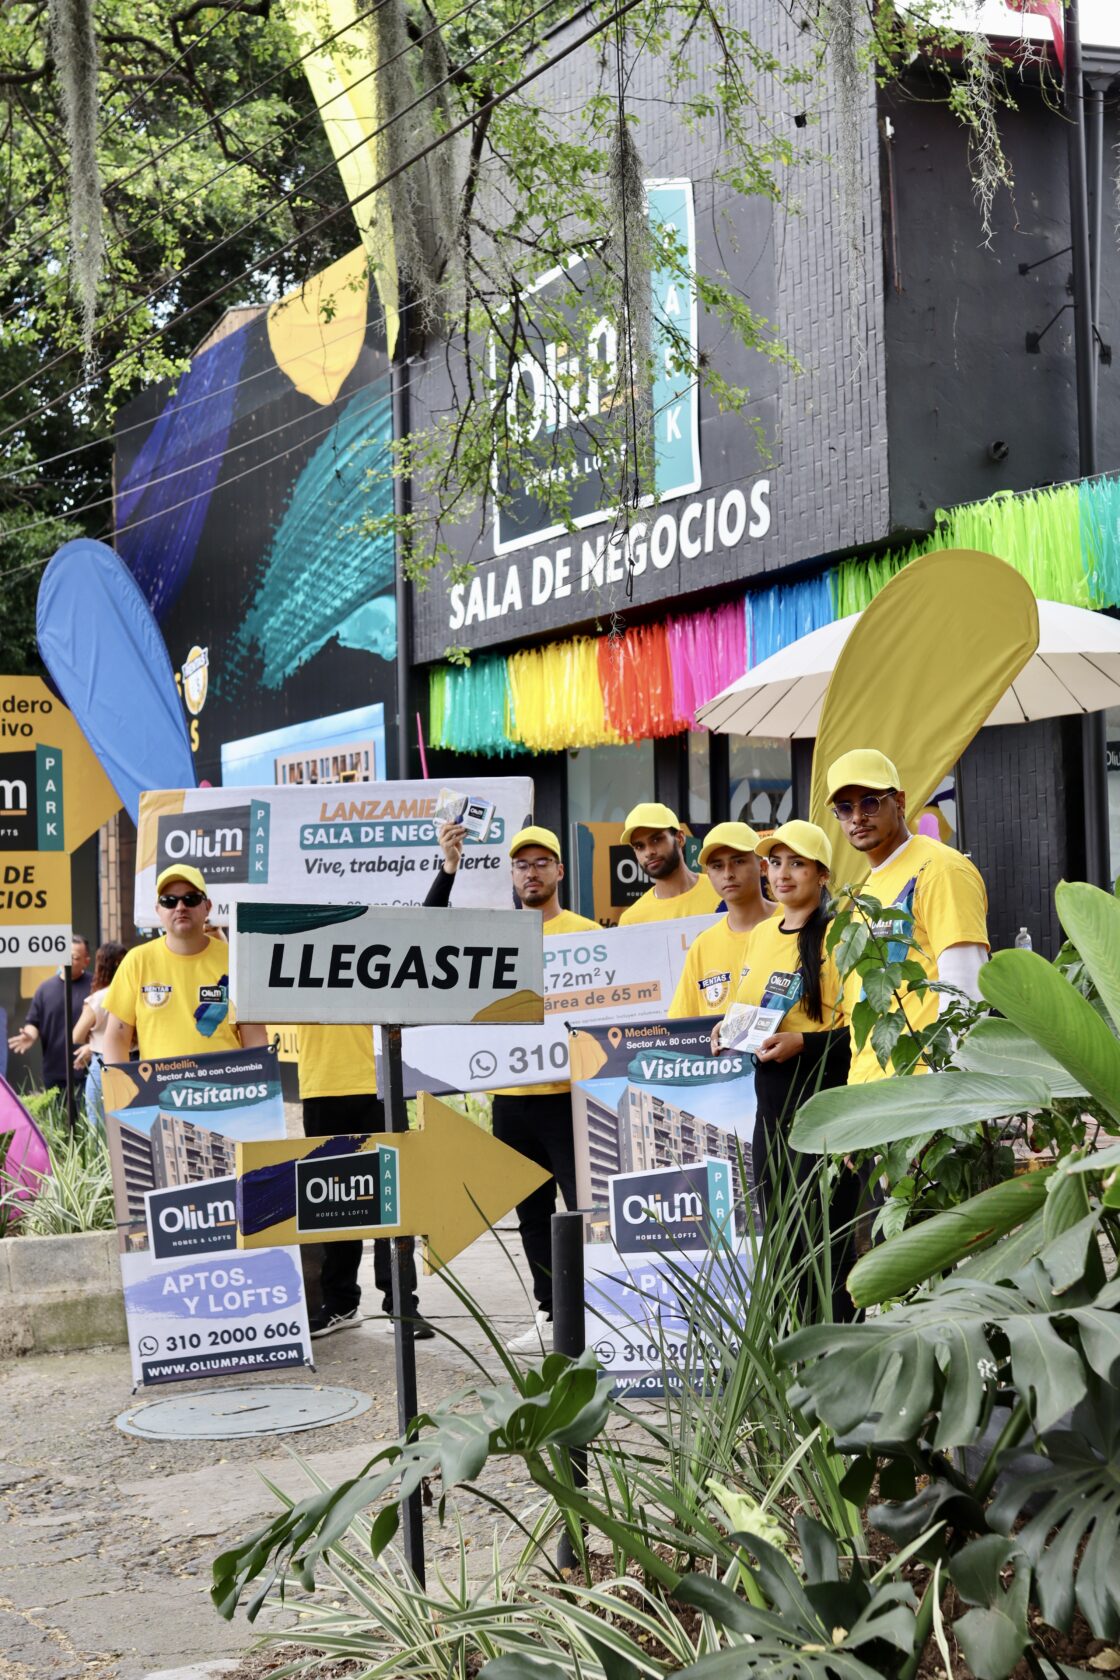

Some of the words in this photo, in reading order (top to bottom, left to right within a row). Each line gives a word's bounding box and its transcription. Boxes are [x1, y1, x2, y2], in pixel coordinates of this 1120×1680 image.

[449, 564, 522, 630] SALA
[532, 547, 571, 606] DE
[581, 479, 771, 591] NEGOCIOS
[0, 695, 53, 713] dero
[45, 757, 57, 836] PARK
[319, 798, 437, 822] LANZAMIE
[164, 828, 243, 858] Olium
[255, 810, 265, 871] PARK
[303, 827, 353, 845] SALA
[360, 826, 384, 843] DE
[391, 821, 502, 841] NEGS
[4, 866, 35, 884] DE
[305, 858, 346, 877] Vive,
[351, 855, 417, 877] trabaja
[419, 858, 429, 871] e
[28, 935, 66, 953] 606
[268, 943, 519, 990] LLEGASTE
[544, 944, 608, 969] PTOS
[605, 969, 616, 986] y
[702, 974, 727, 988] RENTAS
[544, 995, 579, 1011] área
[585, 991, 605, 1005] de
[611, 988, 631, 1002] 65
[624, 1025, 671, 1038] Medellín,
[626, 1041, 653, 1049] Sector
[655, 1039, 667, 1047] Av.
[669, 1038, 679, 1046] 80
[155, 1059, 198, 1072] Medellín,
[508, 1041, 569, 1074] 310
[641, 1057, 742, 1079] Visítanos
[156, 1073, 182, 1082] Sector
[184, 1070, 196, 1079] Av.
[198, 1069, 207, 1077] 80
[225, 1063, 263, 1073] Colombia
[171, 1083, 268, 1107] Visítanos
[305, 1174, 374, 1203] Olium
[383, 1153, 392, 1212] PARK
[622, 1191, 703, 1225] Olium
[714, 1172, 727, 1235] PAR
[159, 1200, 235, 1233] Olium
[172, 1238, 198, 1246] HOMES
[208, 1234, 231, 1242] LOFTS
[162, 1267, 253, 1295] APTOS.
[183, 1296, 200, 1315] Y
[208, 1285, 288, 1313] LOFTS
[166, 1333, 201, 1351] 310
[207, 1326, 257, 1346] 2000
[263, 1321, 301, 1339] 606
[147, 1349, 299, 1377] WWW.OLIUMPARK.COM
[623, 1344, 659, 1362] 310
